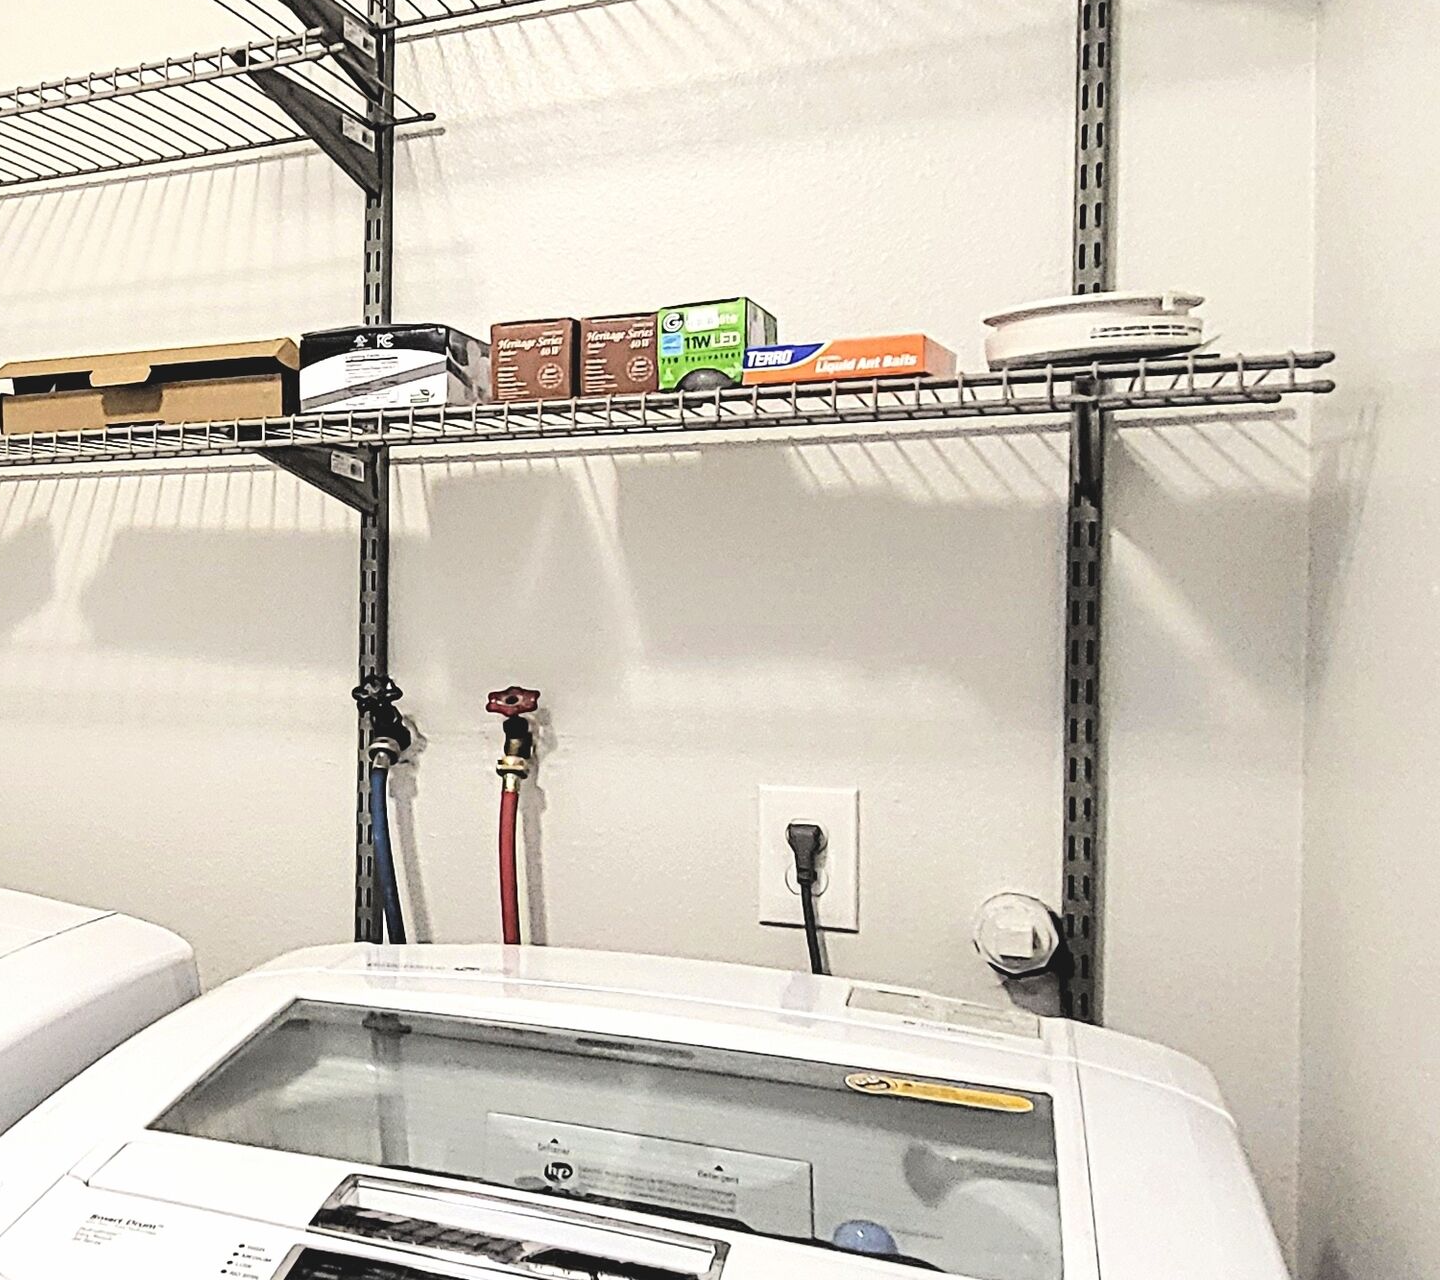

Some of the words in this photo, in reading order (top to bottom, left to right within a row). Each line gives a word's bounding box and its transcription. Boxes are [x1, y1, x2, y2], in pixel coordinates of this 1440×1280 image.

[586, 330, 626, 343] Heritage
[626, 327, 653, 338] Series
[746, 349, 793, 368] TERRO
[815, 358, 855, 375] Liquid
[856, 357, 882, 370] Ant
[882, 353, 918, 368] Baits
